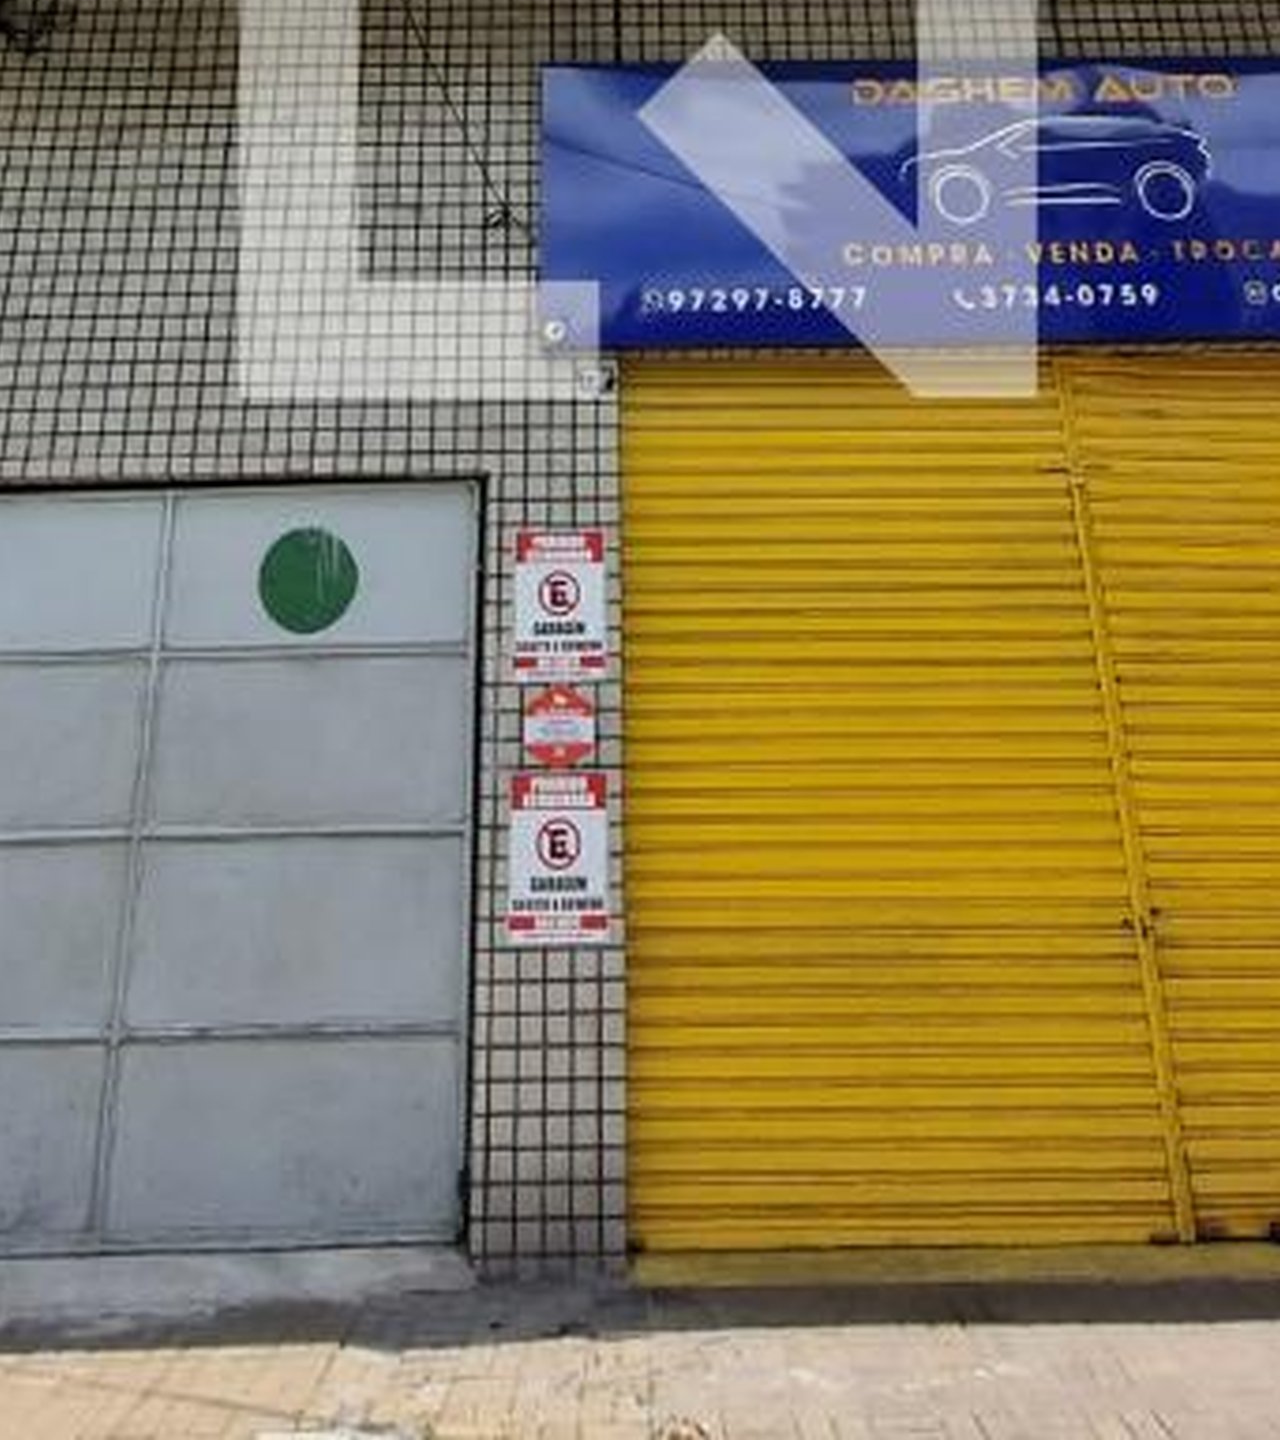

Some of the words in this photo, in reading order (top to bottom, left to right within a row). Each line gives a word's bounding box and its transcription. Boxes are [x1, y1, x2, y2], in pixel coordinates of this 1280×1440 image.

[852, 75, 1074, 105] DASHEM
[1094, 73, 1239, 104] AUTO
[843, 242, 996, 266] COMPRA
[1026, 240, 1139, 263] VENDA
[668, 287, 867, 310] 97297-8777
